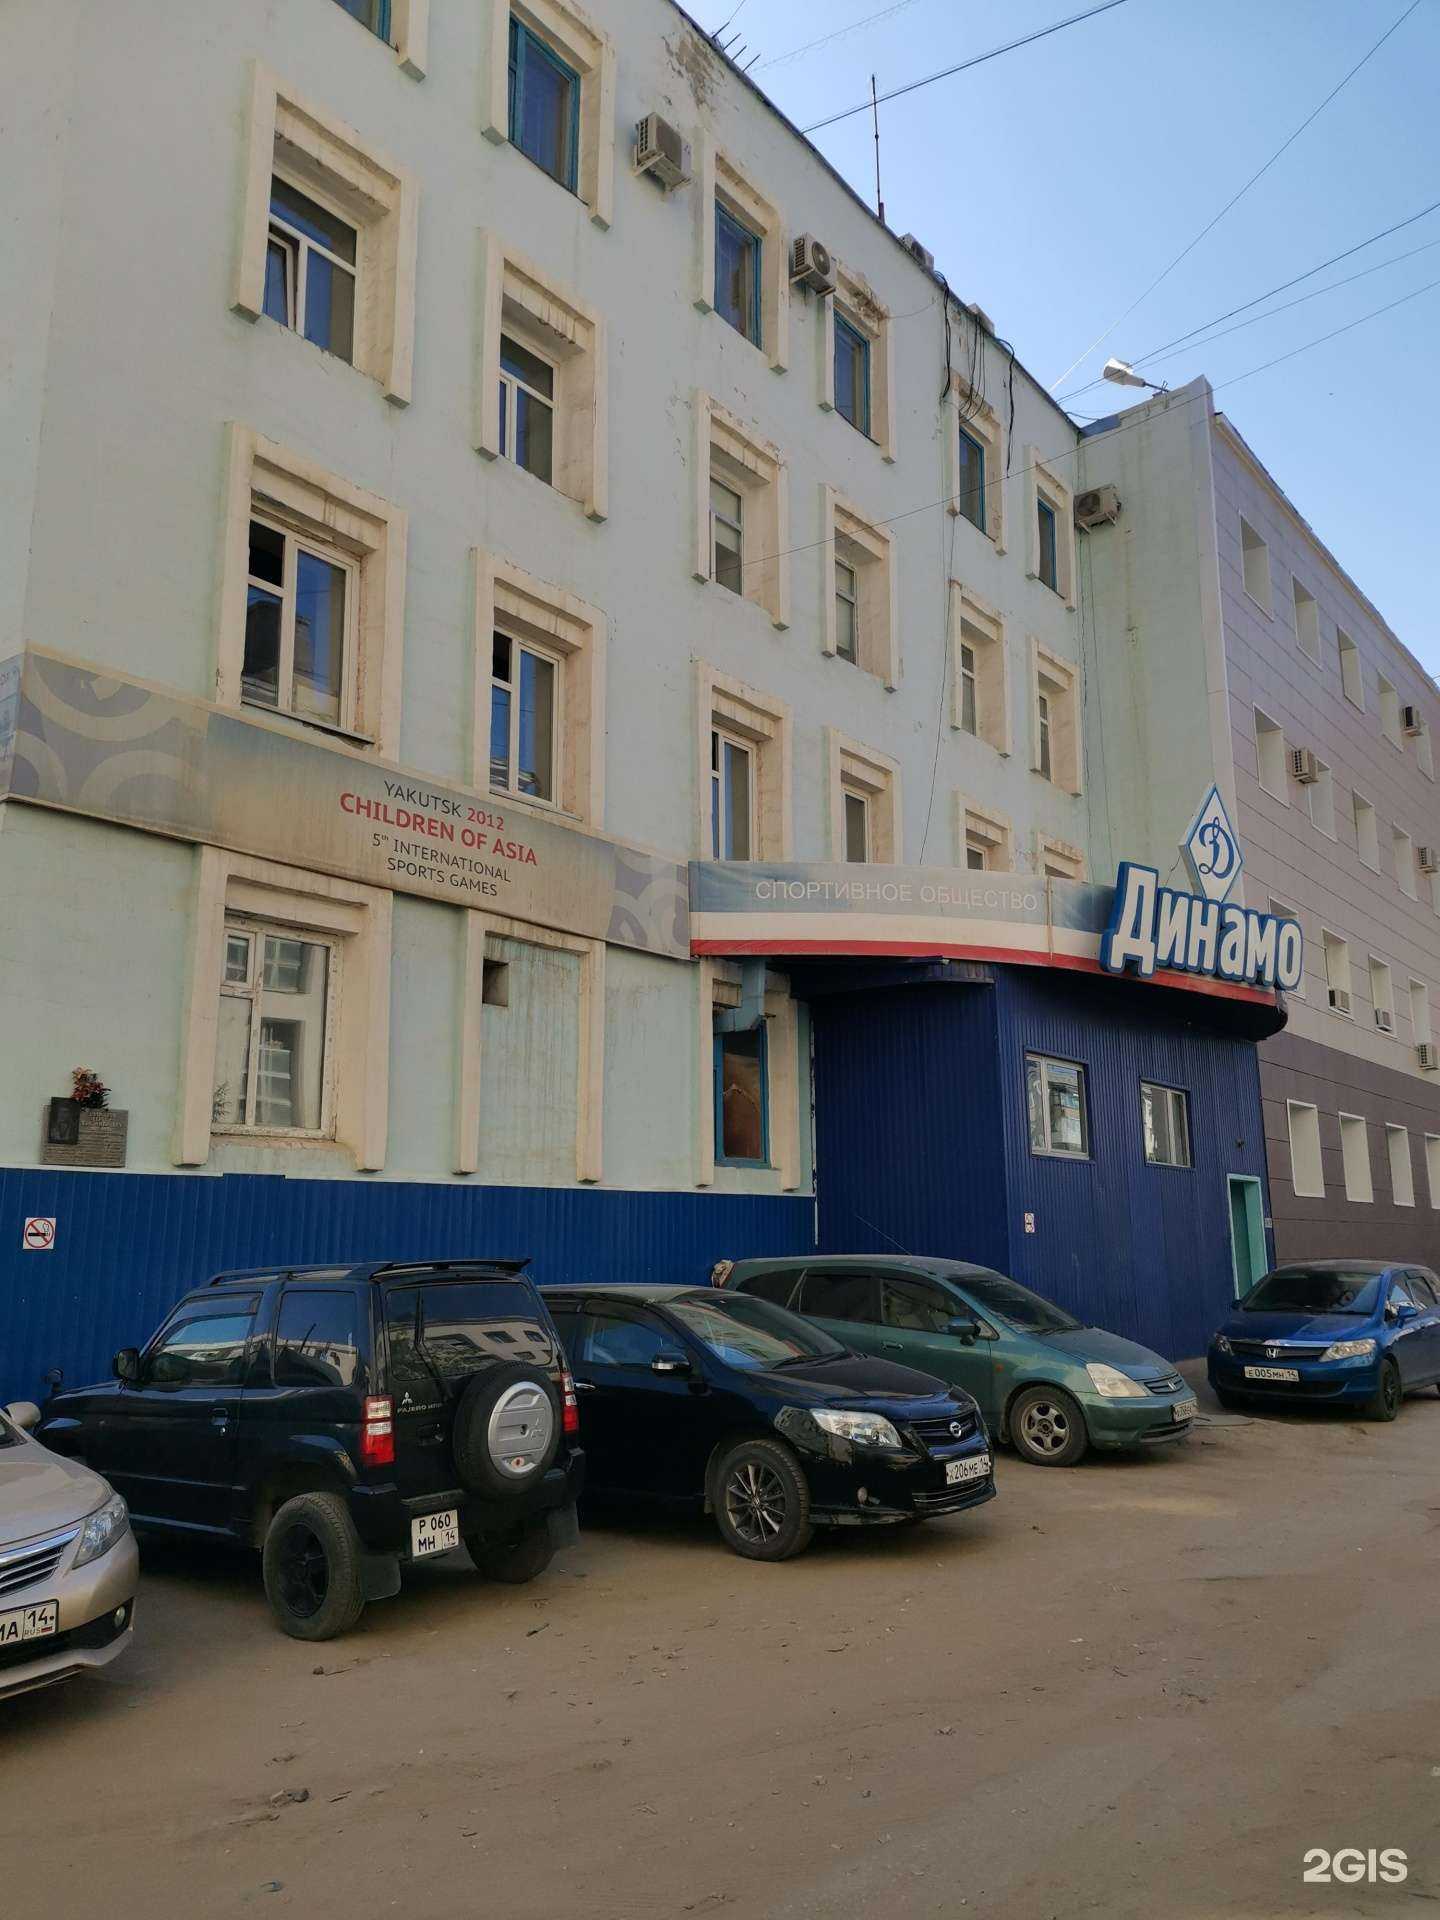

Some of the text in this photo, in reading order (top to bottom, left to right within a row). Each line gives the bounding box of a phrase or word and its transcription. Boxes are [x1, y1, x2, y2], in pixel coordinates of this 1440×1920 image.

[384, 780, 505, 832] YAKUTSK 2012
[340, 792, 538, 866] CHILDREN OF ASIA
[387, 857, 498, 897] SPORTS GAMES
[393, 839, 511, 883] INTERNATIONAL
[755, 880, 1038, 911] СПОРТИВНОЕ ОБЩЕСТВО
